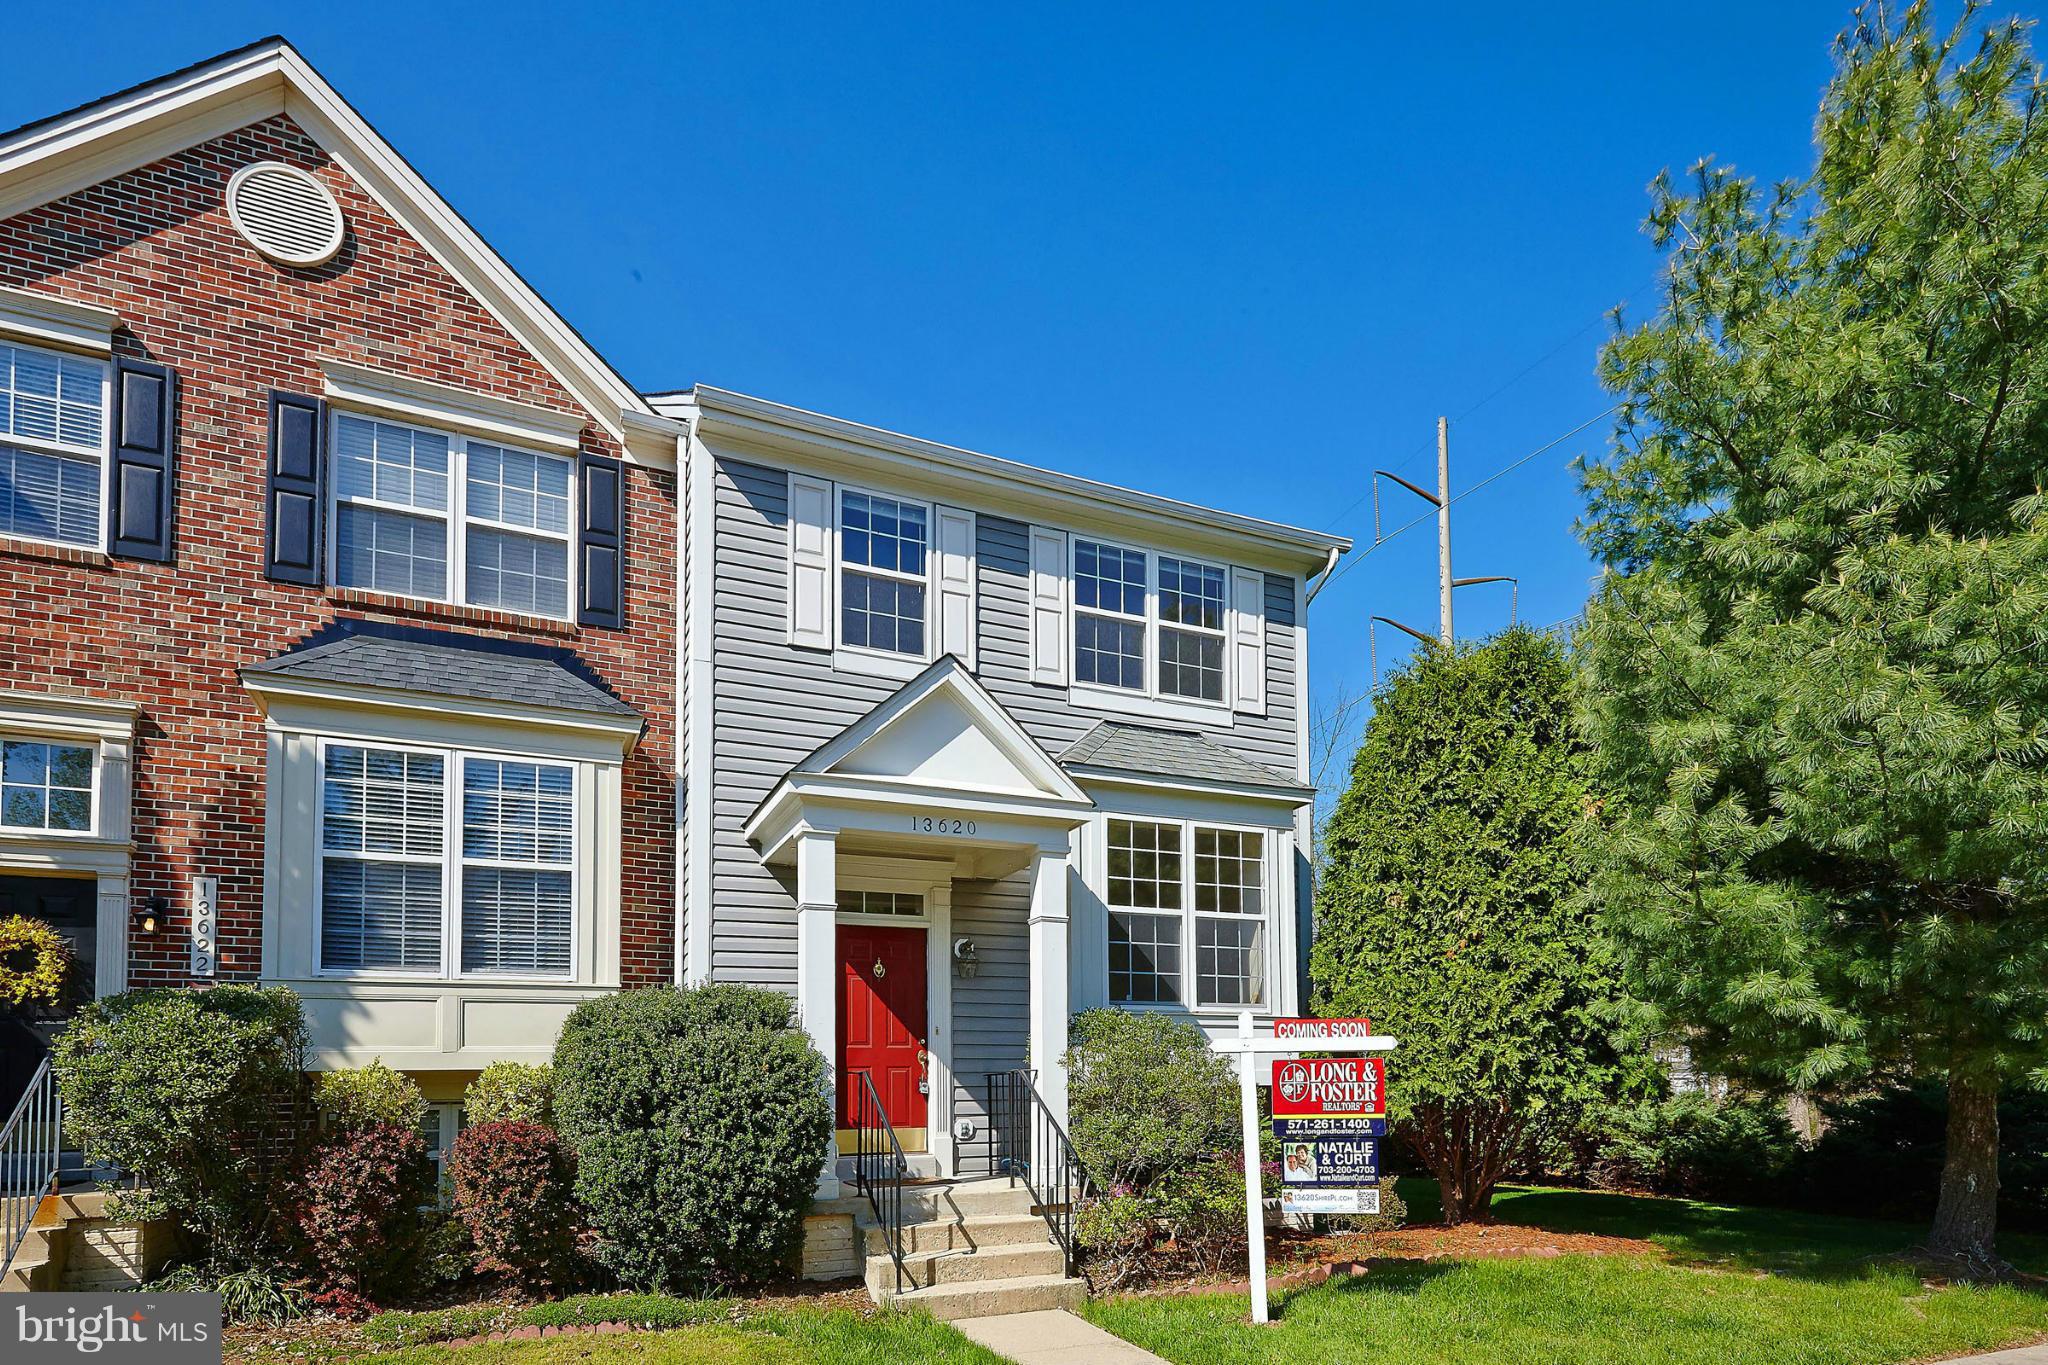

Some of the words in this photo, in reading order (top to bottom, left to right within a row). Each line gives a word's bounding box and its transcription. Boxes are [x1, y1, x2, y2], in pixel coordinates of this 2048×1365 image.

[911, 816, 976, 835] 13620
[196, 882, 210, 971] 13622
[1278, 1023, 1327, 1037] COMING
[1331, 1022, 1366, 1037] SOON
[1309, 1062, 1357, 1082] LONG
[1362, 1061, 1378, 1082] &
[1310, 1082, 1378, 1102] FOSTER
[1287, 1119, 1370, 1129] 571-261-1400
[1318, 1142, 1374, 1154] NATALIE
[1321, 1153, 1331, 1165] &
[1334, 1153, 1372, 1165] CURT
[1318, 1165, 1375, 1174] 703-200-4703
